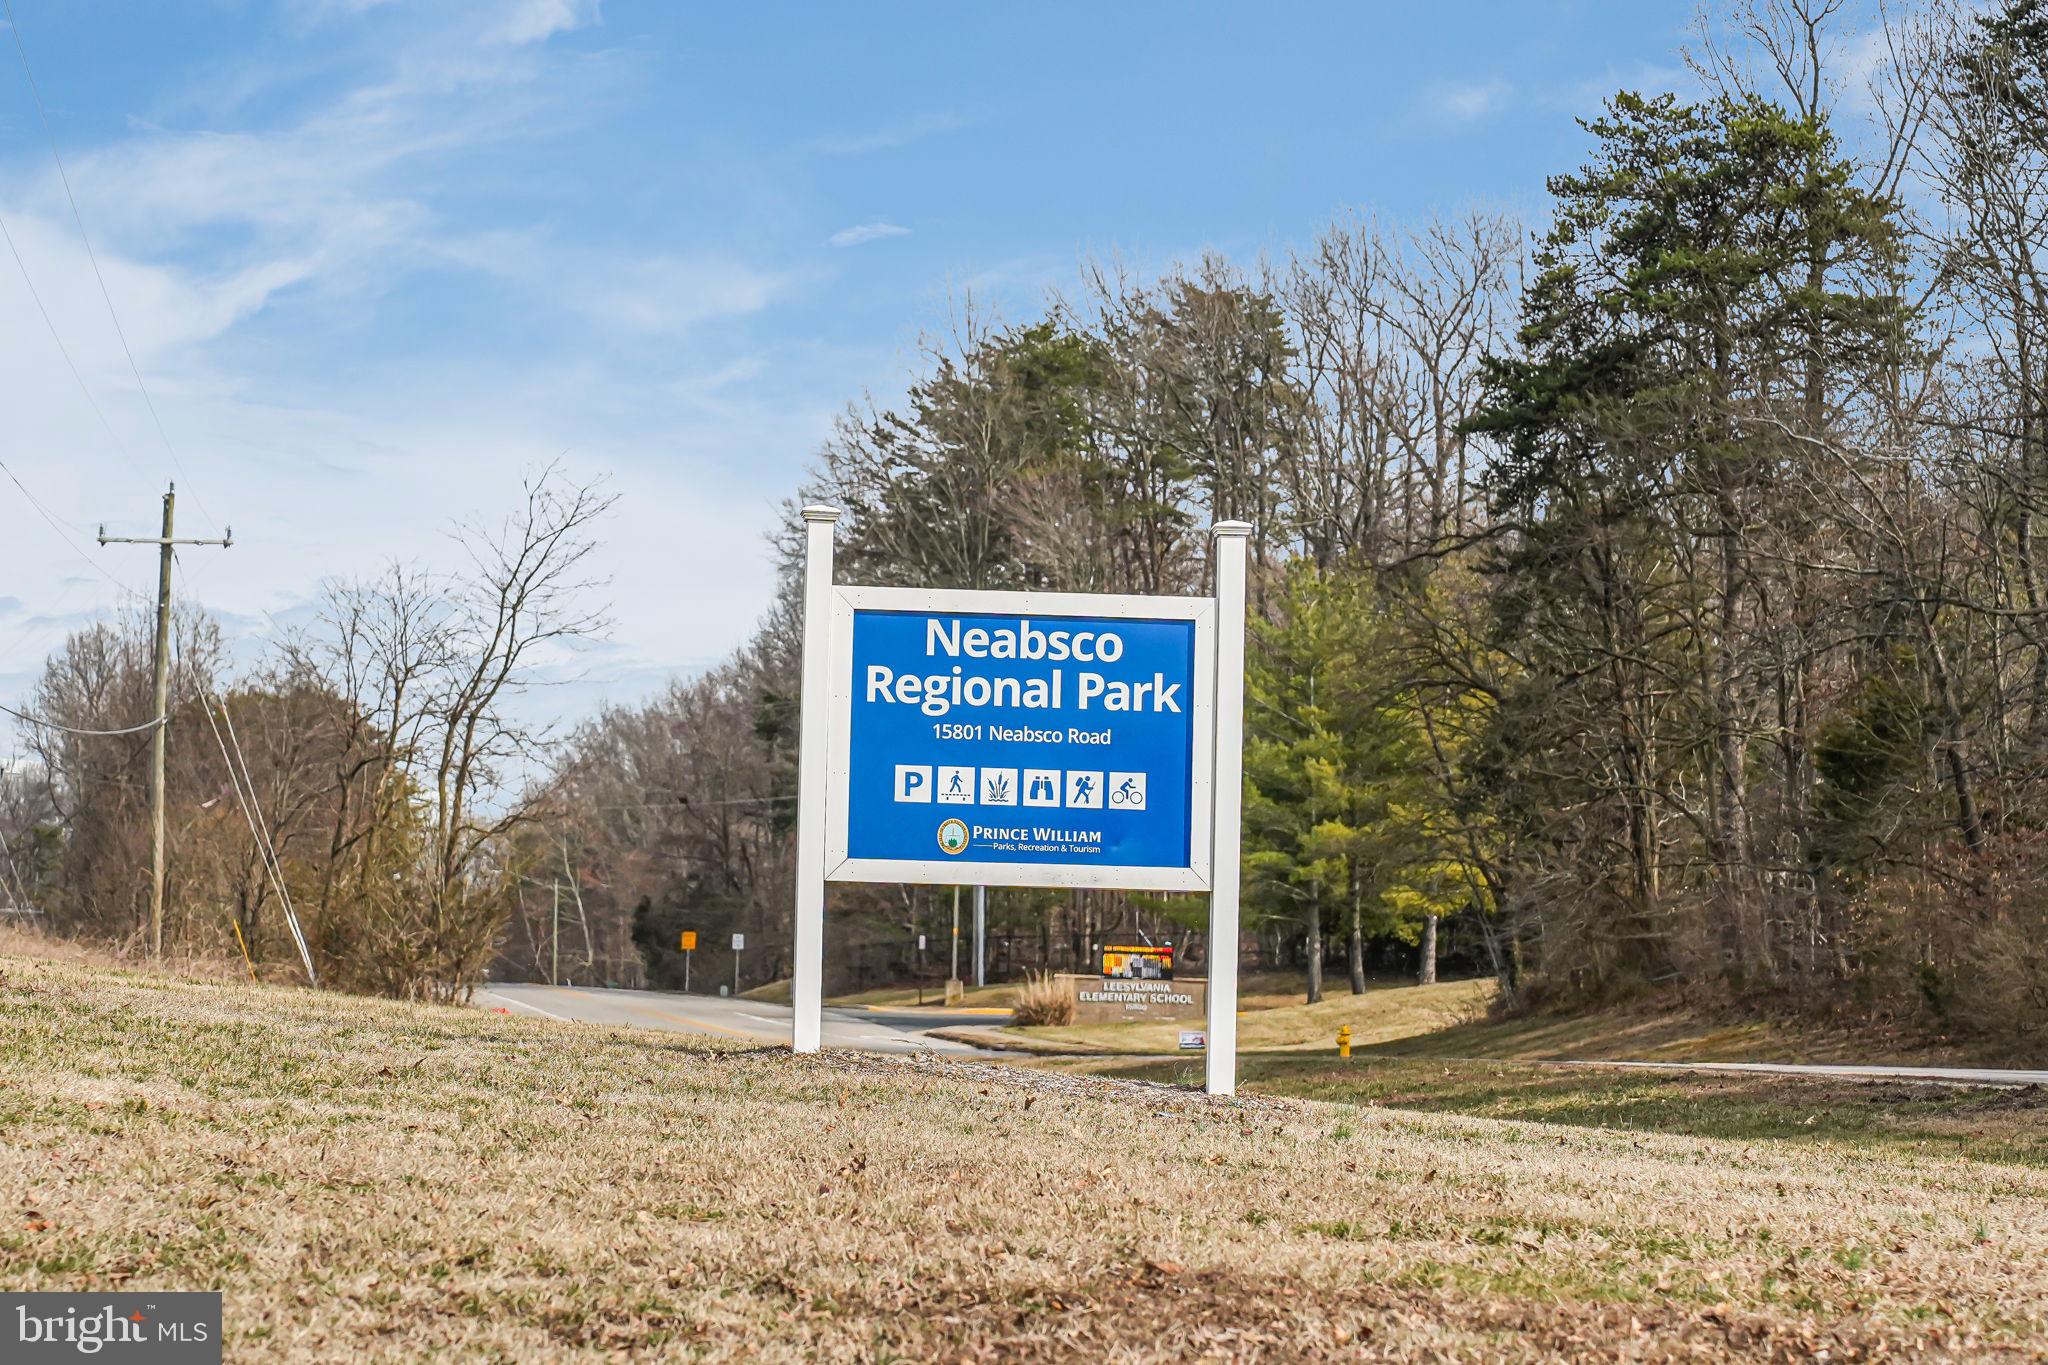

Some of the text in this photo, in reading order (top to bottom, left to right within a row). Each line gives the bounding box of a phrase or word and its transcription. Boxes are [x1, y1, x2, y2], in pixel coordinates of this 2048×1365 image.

[926, 619, 1124, 662] Neabsco
[866, 665, 1182, 717] Regional Park
[932, 723, 1111, 745] 15801 Neabsco Road
[904, 771, 924, 797] P
[973, 825, 1029, 841] PRINCE
[1033, 827, 1101, 842] WILLIAM
[993, 843, 1016, 851] Parks,
[1018, 844, 1058, 853] Recreation
[1069, 845, 1101, 853] Tourism
[1103, 982, 1171, 993] LEESYLVANIA
[1079, 991, 1194, 1004] ELEMENTARY SCHOOL
